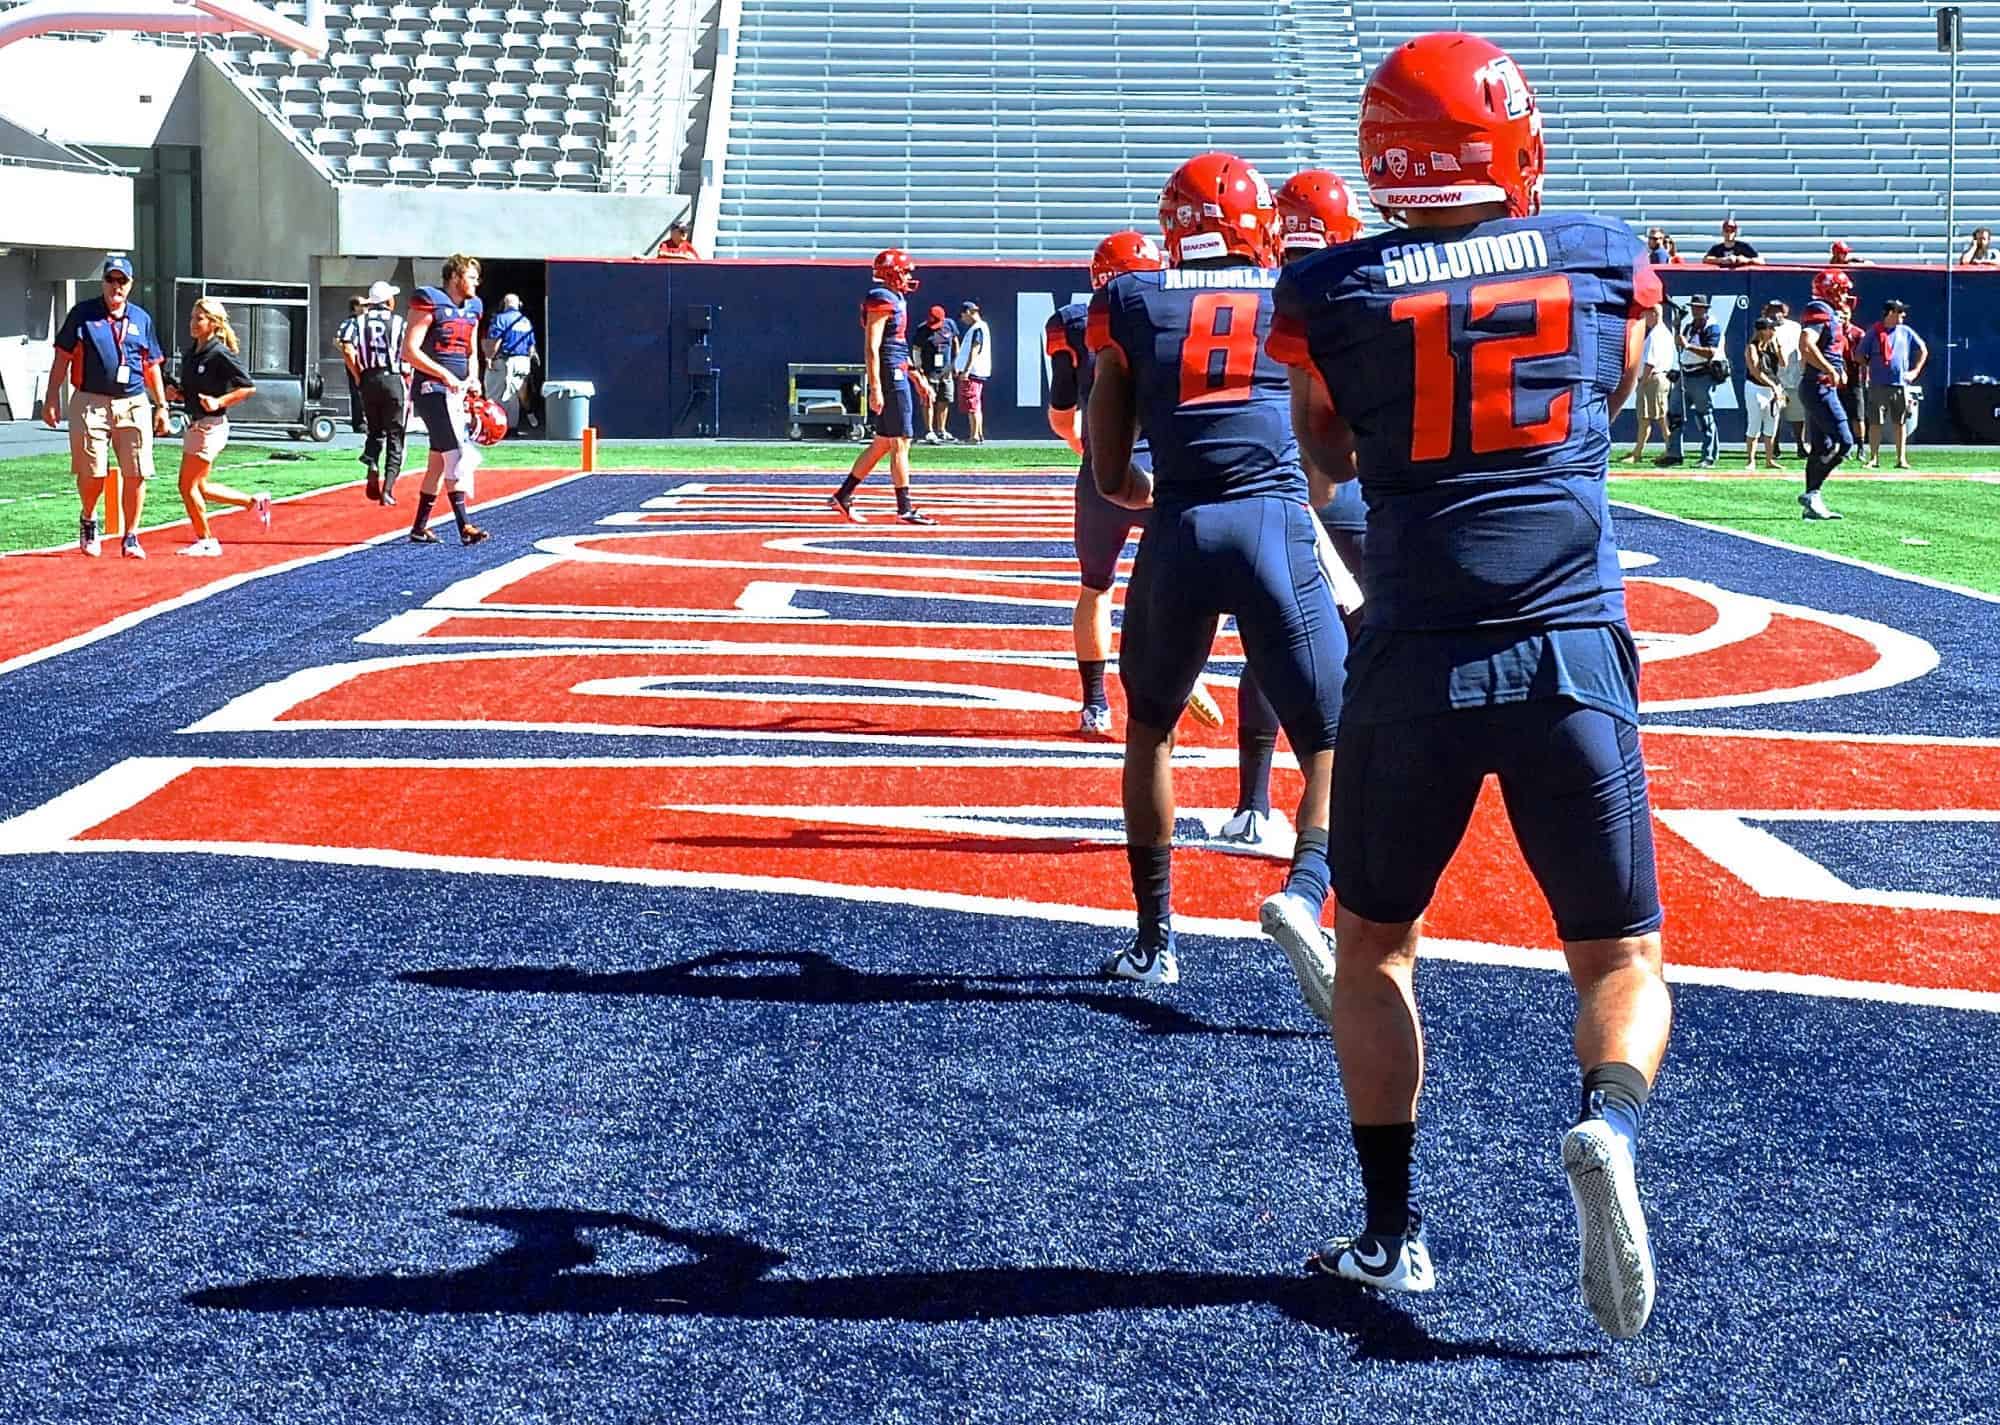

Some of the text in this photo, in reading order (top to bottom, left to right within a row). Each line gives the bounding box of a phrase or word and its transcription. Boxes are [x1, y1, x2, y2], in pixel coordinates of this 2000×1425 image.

[1414, 162, 1427, 177] 12
[1387, 191, 1462, 205] BEARDOWN
[1381, 230, 1549, 288] SOLOMON
[367, 319, 387, 348] R
[1177, 292, 1261, 406] 8
[1390, 274, 1572, 462] 12
